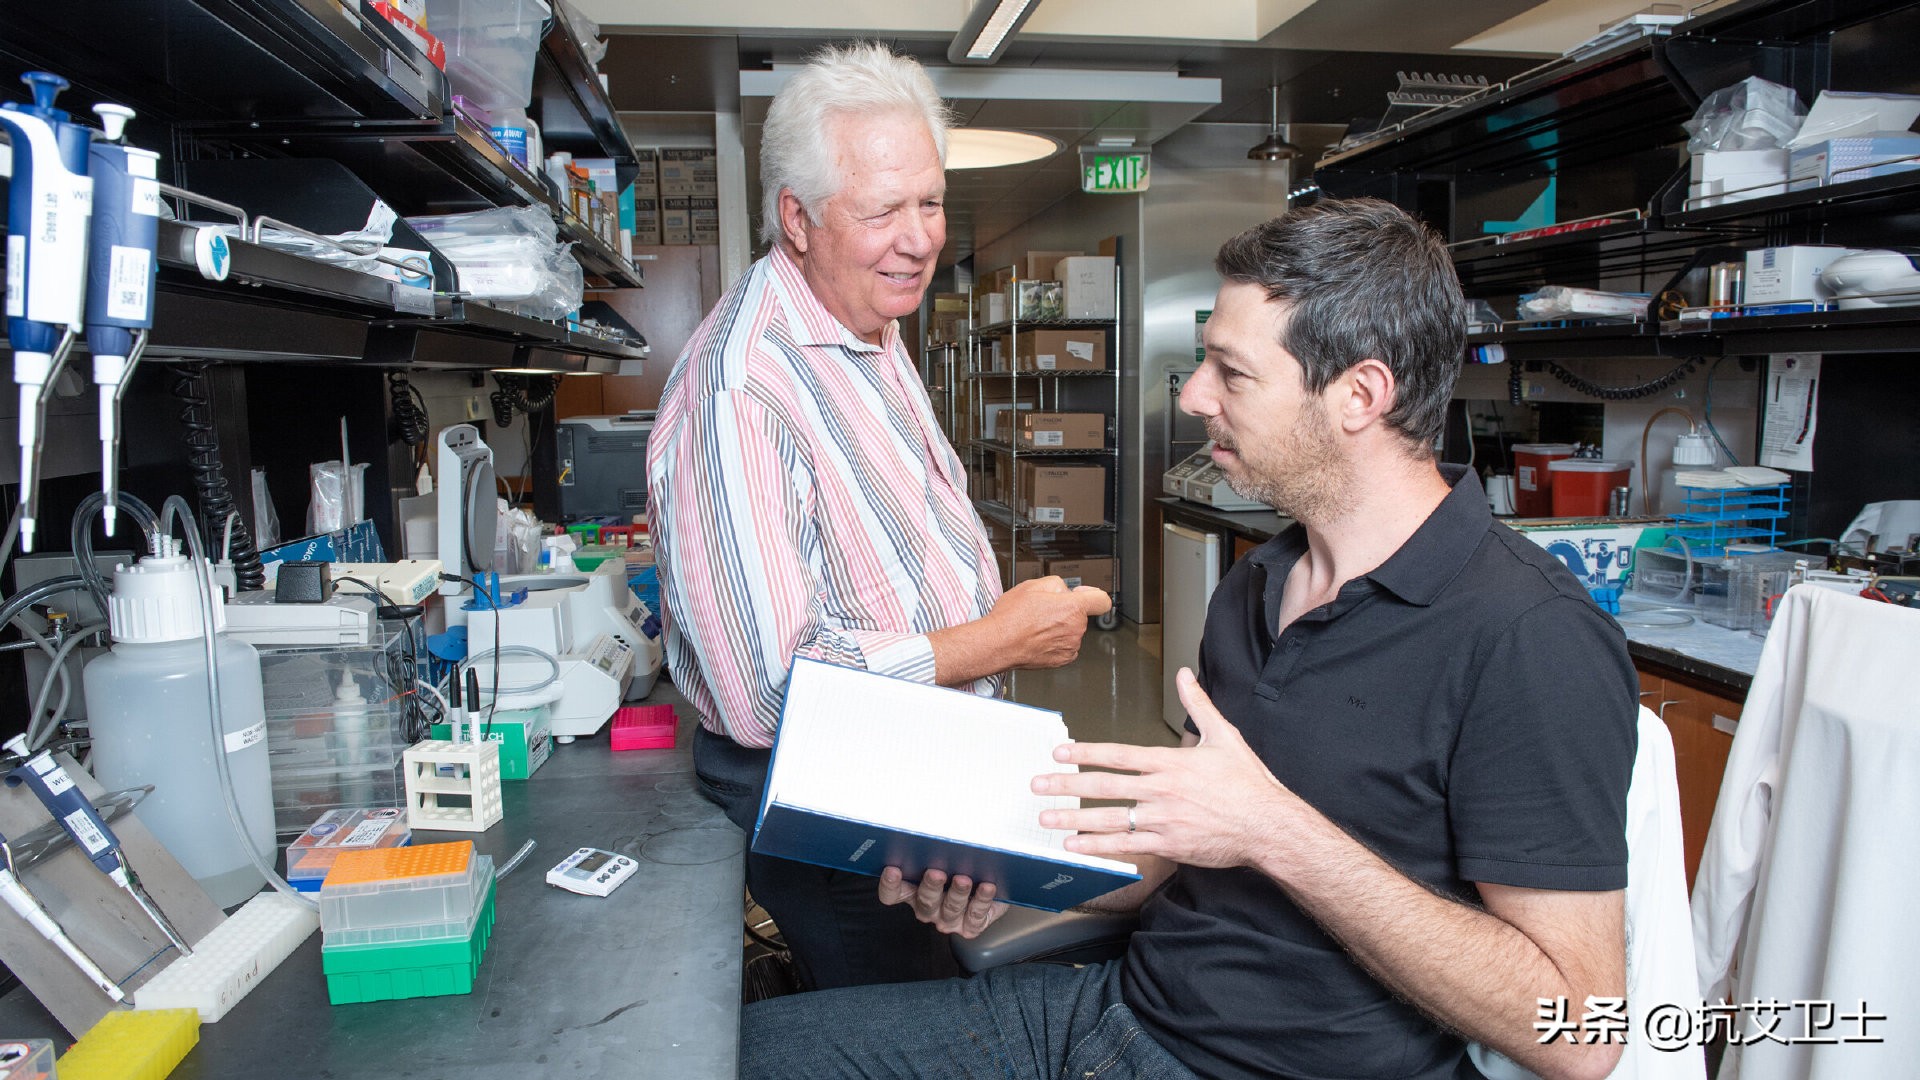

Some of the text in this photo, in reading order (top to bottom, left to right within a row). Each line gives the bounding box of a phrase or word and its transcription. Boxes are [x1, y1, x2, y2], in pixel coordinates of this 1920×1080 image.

[503, 129, 523, 139] AWAY
[1094, 156, 1141, 189] EXIT
[301, 541, 318, 561] QIAG
